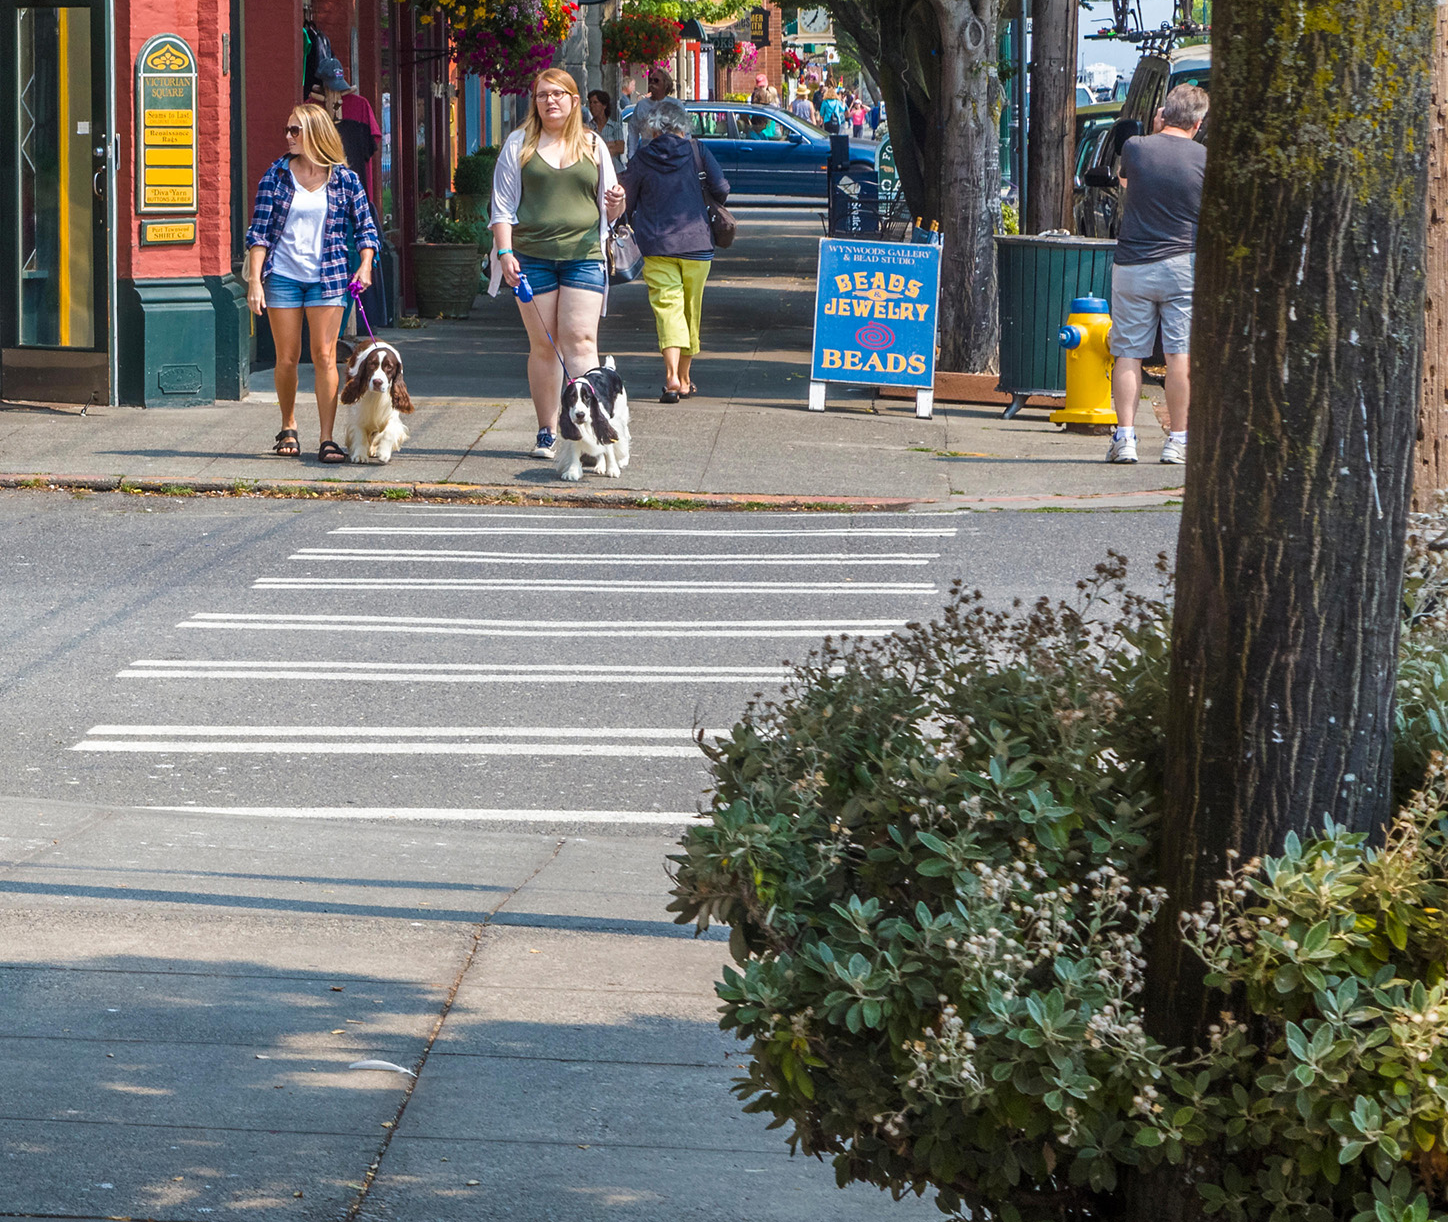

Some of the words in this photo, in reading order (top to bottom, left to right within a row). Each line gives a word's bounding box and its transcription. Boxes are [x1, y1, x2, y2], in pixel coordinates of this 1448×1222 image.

[145, 77, 191, 87] VICTORIAN
[151, 87, 184, 99] SQUARE
[828, 244, 886, 256] WYNWOODS
[887, 248, 932, 259] GALLERY
[843, 254, 852, 262] &
[854, 255, 880, 264] BEAD
[881, 256, 916, 266] STUDIO
[834, 271, 924, 299] BEADS
[824, 297, 930, 322] JEWELRY
[821, 348, 927, 375] BEADS
